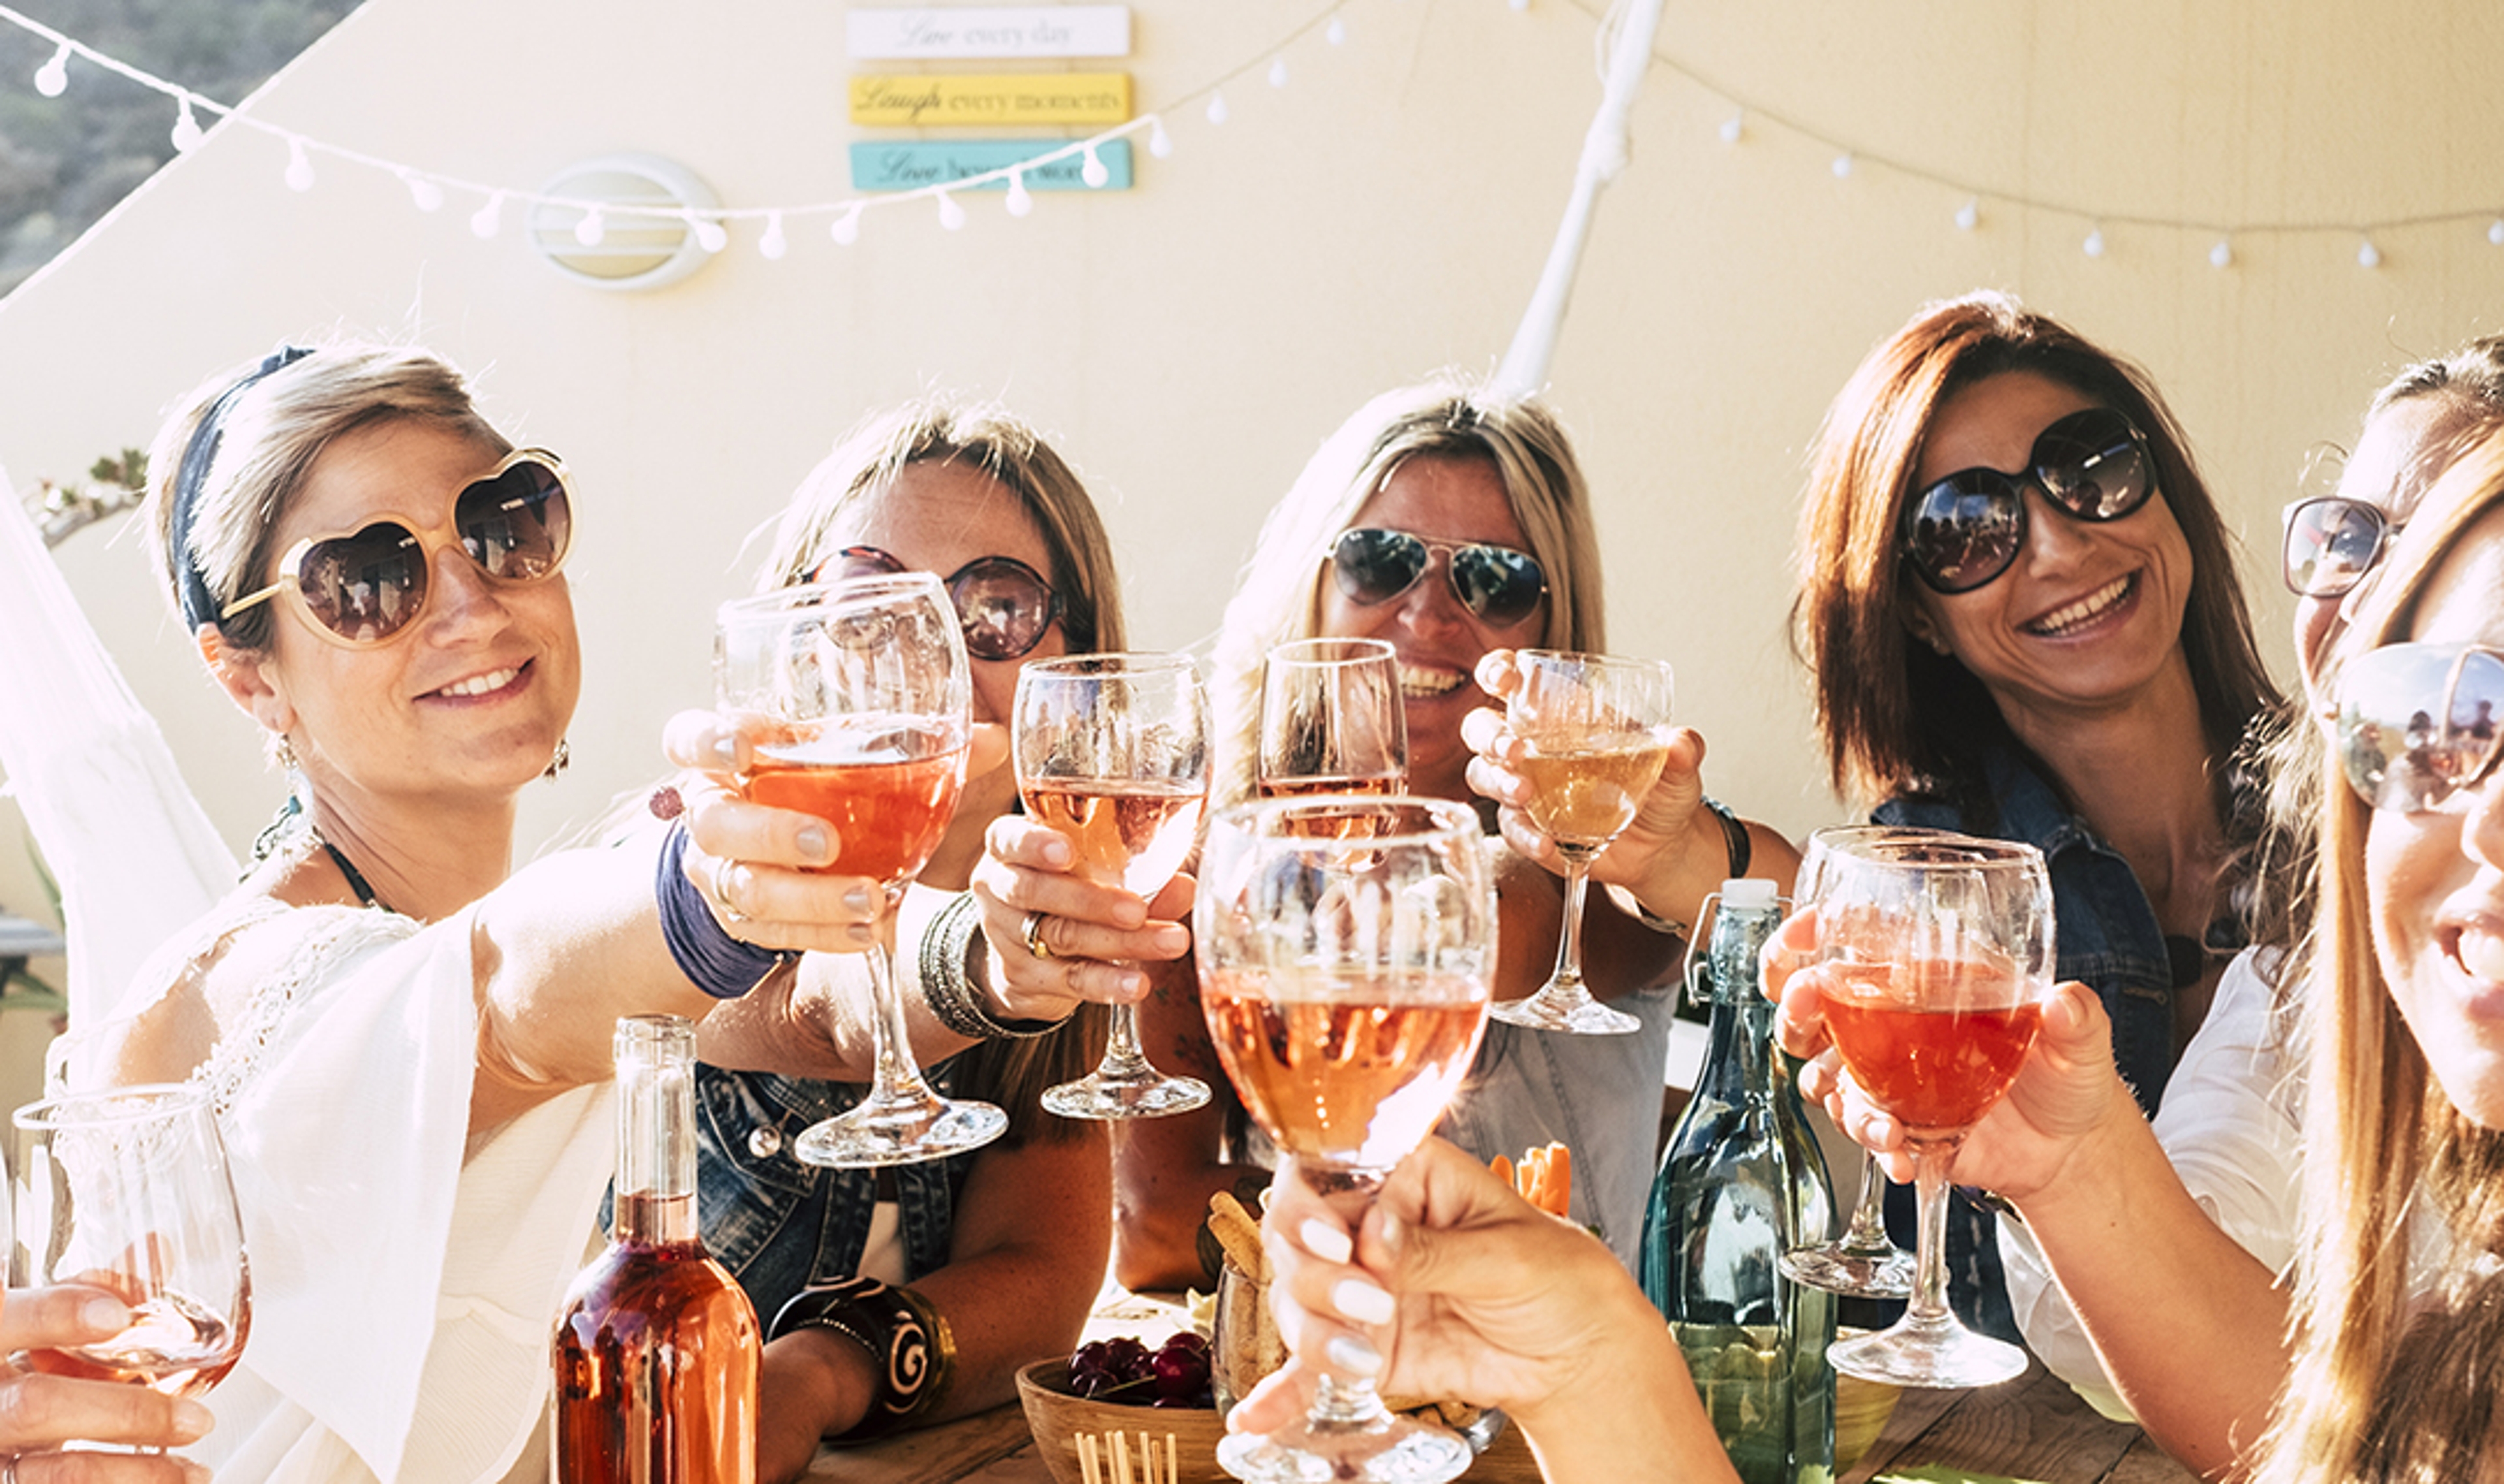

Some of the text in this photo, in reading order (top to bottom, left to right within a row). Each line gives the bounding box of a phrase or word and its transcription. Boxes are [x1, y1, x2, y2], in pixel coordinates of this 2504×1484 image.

[897, 10, 1071, 48] Live every day
[856, 76, 940, 125] Laugh
[949, 92, 1007, 116] every
